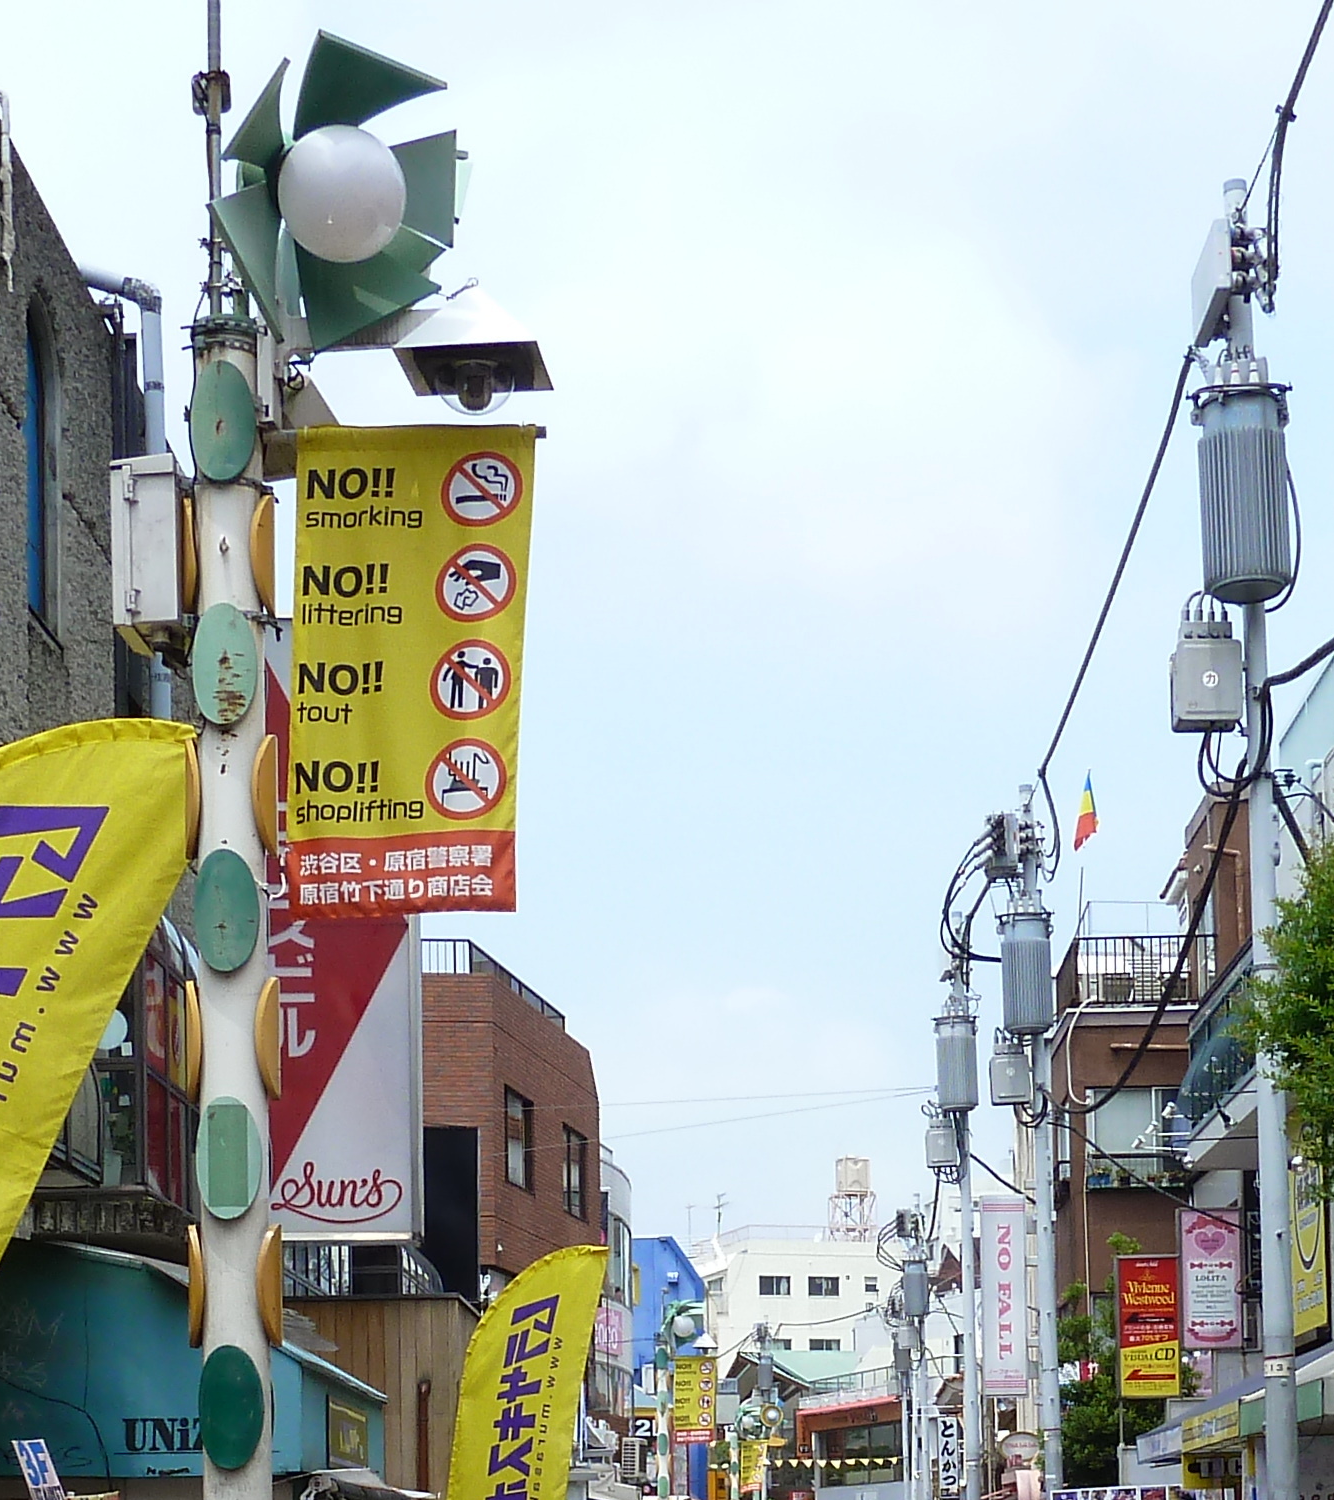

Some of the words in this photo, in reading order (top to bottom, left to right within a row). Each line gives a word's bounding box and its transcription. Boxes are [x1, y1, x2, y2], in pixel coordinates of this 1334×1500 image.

[306, 467, 396, 499] NO!!
[305, 505, 423, 529] smorking
[303, 563, 389, 597] NO!!
[302, 603, 403, 627] littering
[298, 662, 384, 695] NO!!
[297, 702, 353, 724] tout
[295, 760, 380, 795] NO!!
[295, 799, 424, 826] shoplifting
[300, 845, 493, 874] 渋谷区・原宿警察署
[300, 873, 494, 905] 原宿竹下通り商店会
[1122, 1292, 1175, 1306] Westwood
[1127, 1281, 1170, 1294] Vivienne
[19, 1440, 50, 1487] 3F
